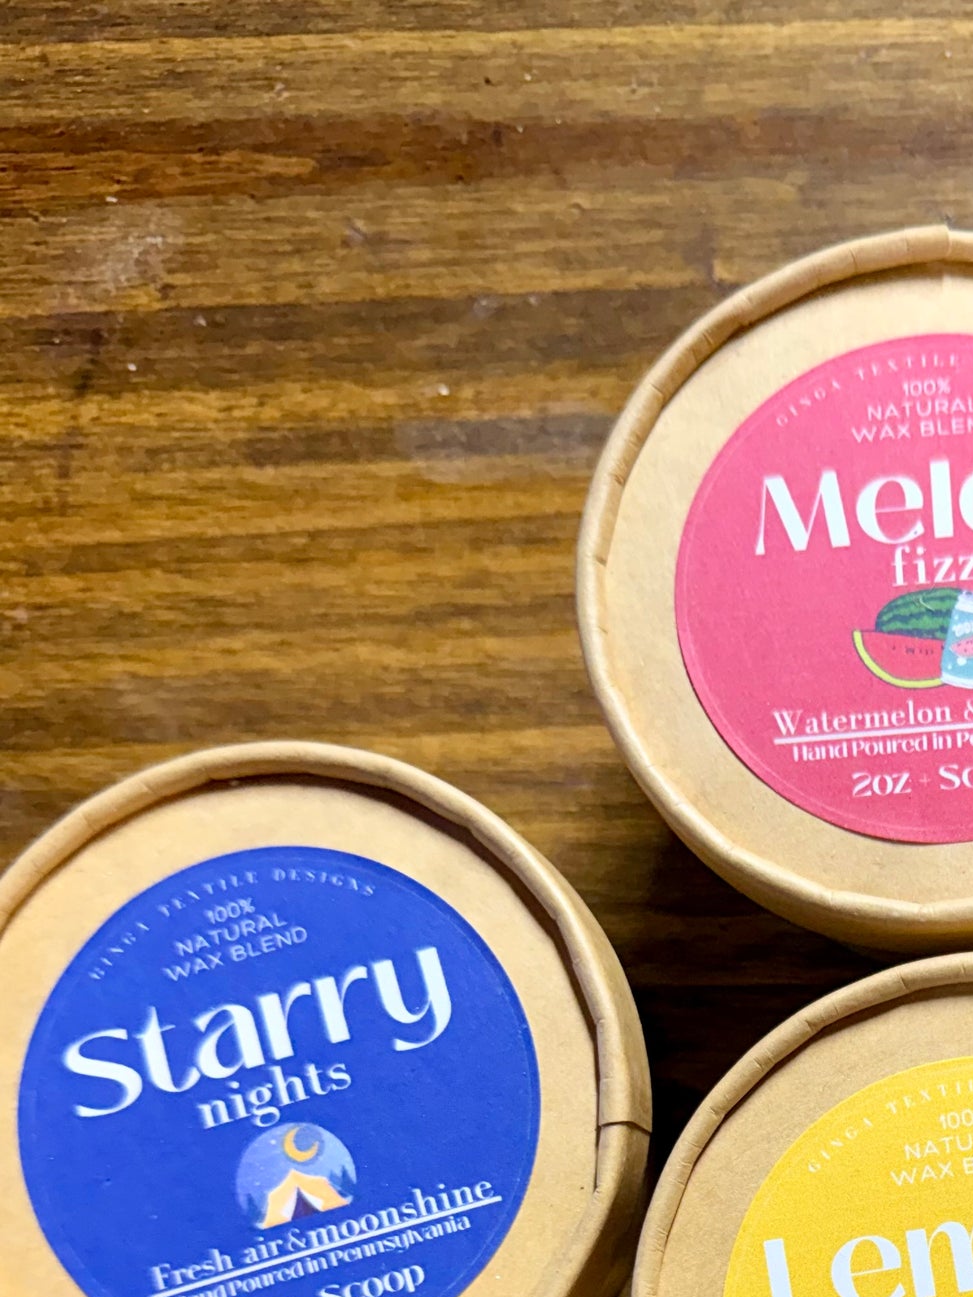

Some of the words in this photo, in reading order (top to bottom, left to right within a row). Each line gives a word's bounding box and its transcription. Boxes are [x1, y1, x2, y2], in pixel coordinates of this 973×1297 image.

[856, 354, 957, 381] TEXTILE
[903, 378, 951, 397] 100%
[852, 424, 911, 443] WAX
[773, 700, 952, 736] Watermelon
[793, 737, 849, 762] Hand
[851, 736, 927, 757] Poured
[933, 732, 952, 750] in
[852, 771, 911, 798] 2oz
[273, 868, 376, 896] DESIGNS
[204, 898, 256, 924] 100%
[174, 912, 287, 956] NATURAL
[162, 952, 224, 982] WAX
[229, 927, 308, 961] BLEND
[62, 946, 452, 1118] Starry
[198, 1062, 353, 1130] nights
[891, 1161, 954, 1186] WAX
[329, 1214, 471, 1268] Pennsylvania
[151, 1248, 234, 1290] Fresh
